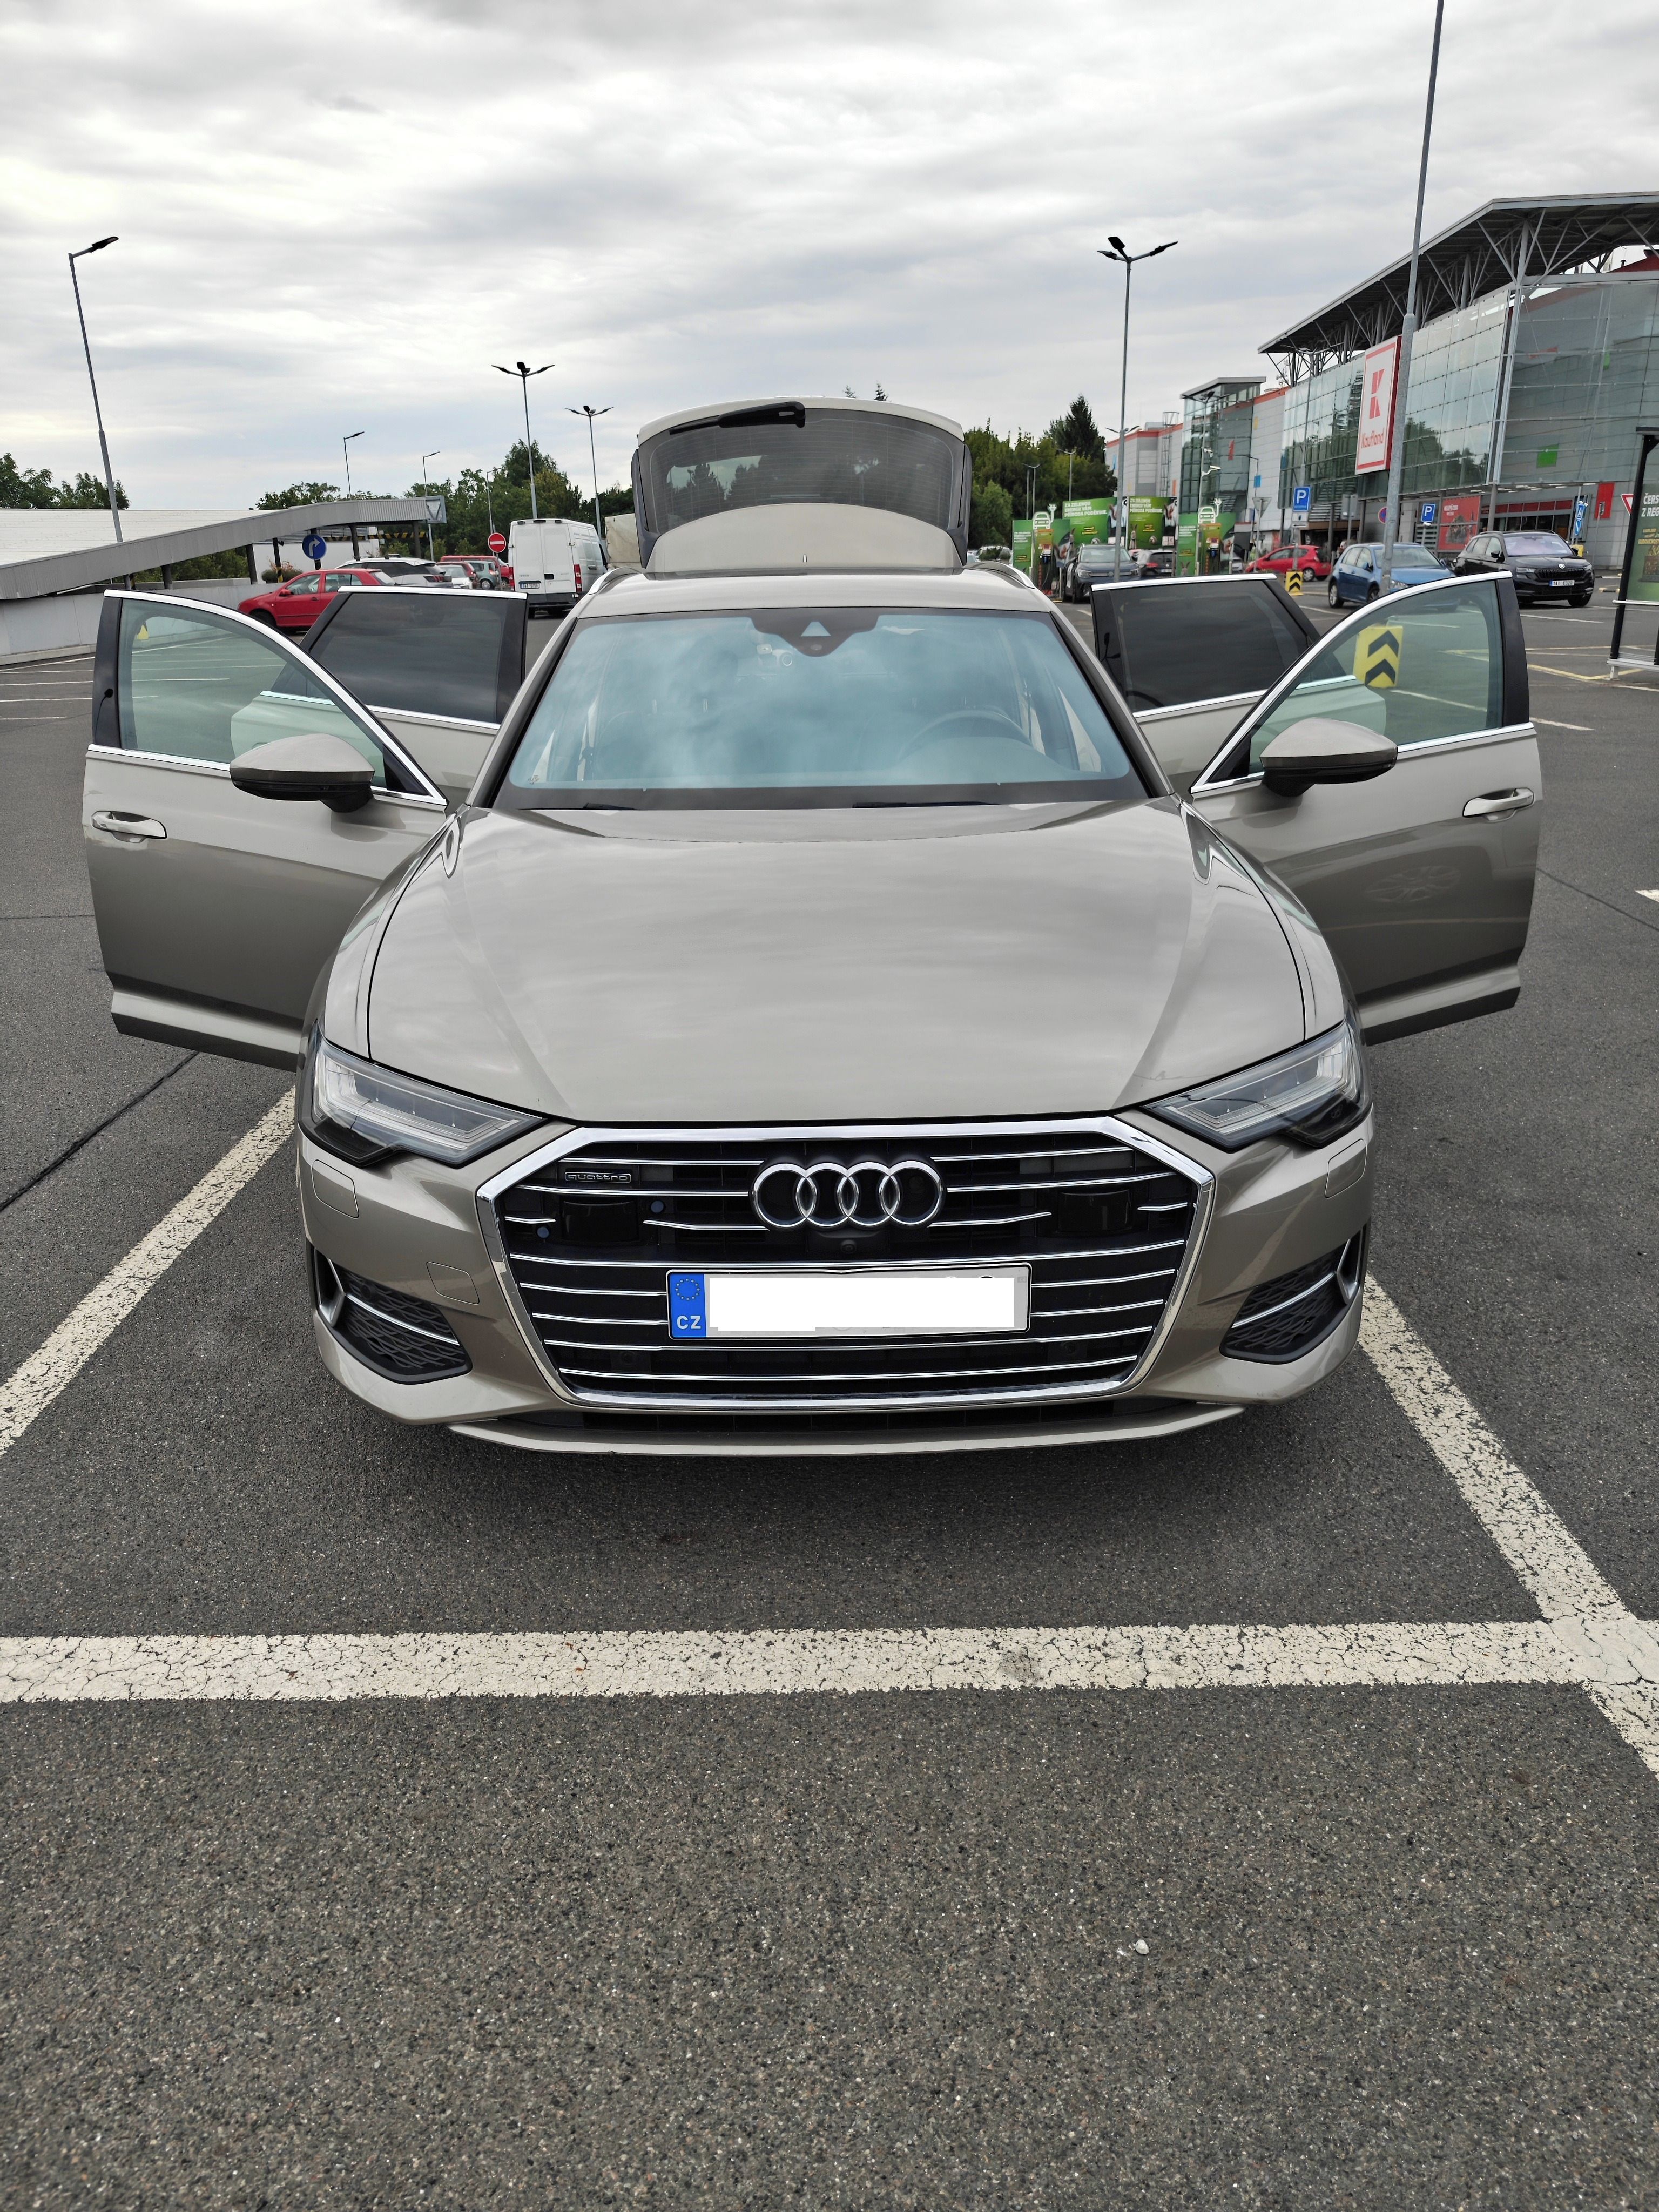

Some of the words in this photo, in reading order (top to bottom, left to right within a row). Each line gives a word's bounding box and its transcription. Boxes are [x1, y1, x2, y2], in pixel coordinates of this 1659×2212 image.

[1361, 428, 1385, 449] Kaufland
[1297, 489, 1306, 504] P
[1424, 505, 1432, 516] P
[1642, 508, 1647, 517] Z
[677, 1315, 702, 1330] CZ
